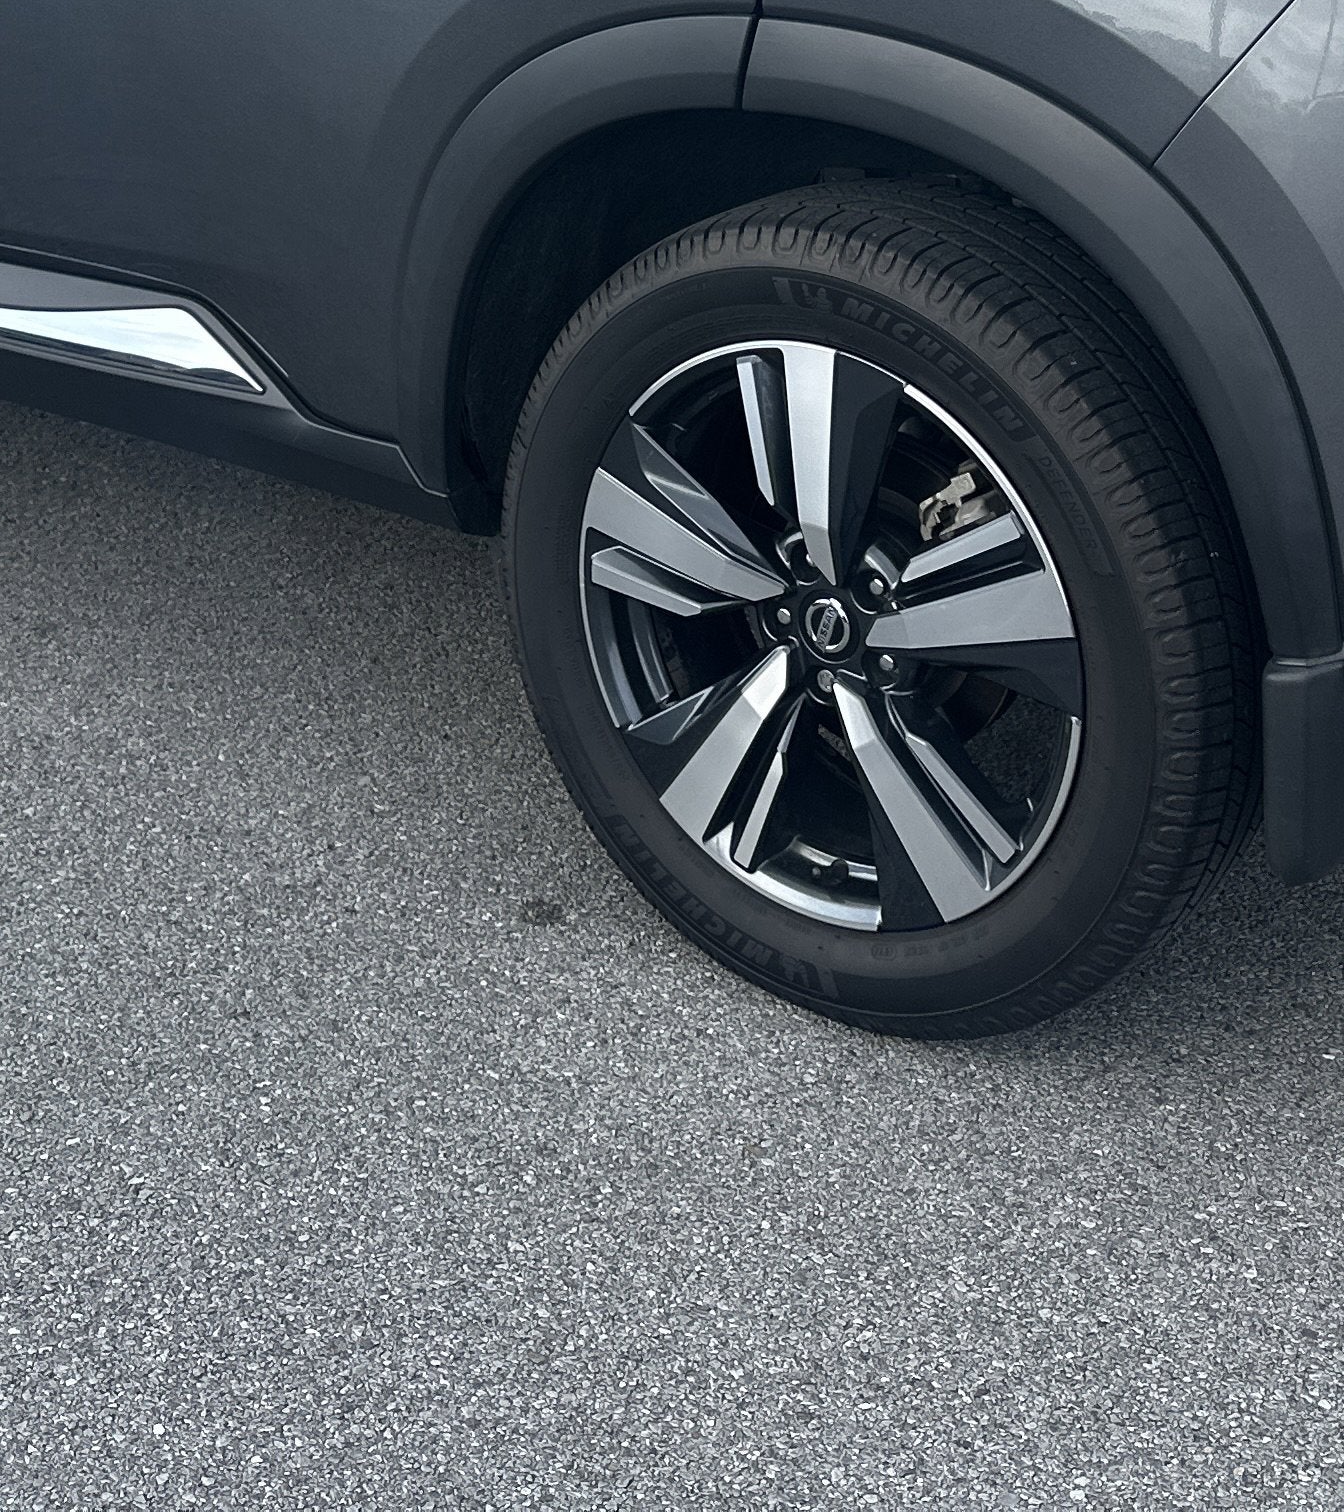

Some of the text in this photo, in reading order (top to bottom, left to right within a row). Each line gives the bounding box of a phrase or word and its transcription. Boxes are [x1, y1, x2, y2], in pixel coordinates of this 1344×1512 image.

[841, 297, 1025, 433] MICHELIN
[1037, 455, 1098, 550] DEFENDER
[817, 607, 837, 648] NISSAN
